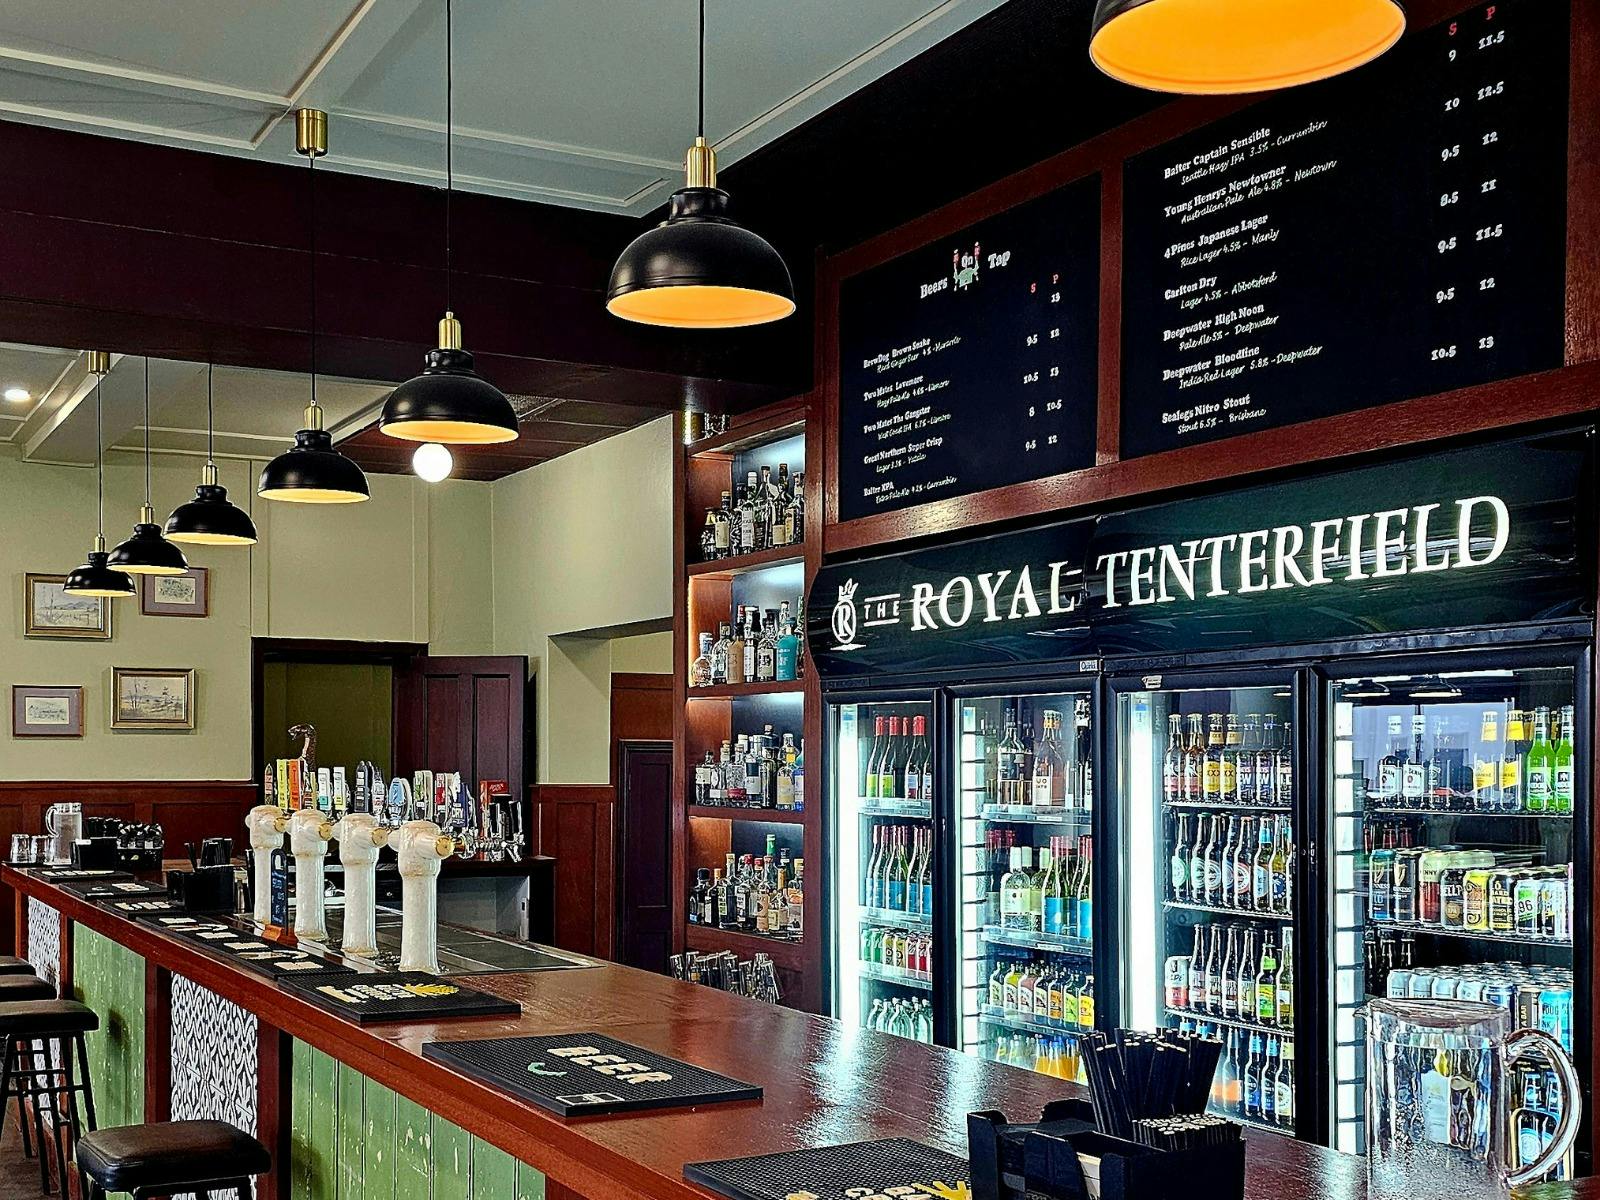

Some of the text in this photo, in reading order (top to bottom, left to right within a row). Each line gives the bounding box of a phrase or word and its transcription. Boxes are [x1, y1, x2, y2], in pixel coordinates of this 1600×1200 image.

[1486, 6, 1496, 20] P
[1449, 22, 1457, 36] S
[1478, 30, 1505, 49] 11.5
[1449, 50, 1456, 61] 9
[1478, 81, 1504, 100] 12.5
[1445, 98, 1460, 111] 10
[1482, 132, 1498, 145] 12
[1164, 127, 1271, 179] Balter Captain Sensible
[1181, 168, 1208, 185] Seattle
[1230, 153, 1245, 166] IPA
[1249, 142, 1269, 157] 3.5%
[1276, 120, 1327, 146] Currumbin
[1441, 145, 1460, 161] 9.5
[1164, 165, 1287, 217] Young Henrys Newtowner
[1181, 200, 1224, 224] Australian
[1225, 193, 1244, 208] Pale
[1248, 185, 1263, 199] Ale
[1263, 180, 1282, 192] 4.8%
[1294, 160, 1337, 182] Newtown
[1481, 179, 1496, 192] 11
[1440, 191, 1458, 206] 8.5
[1198, 223, 1239, 246] Japanese
[1241, 213, 1268, 231] Lager
[1476, 224, 1502, 240] 11.5
[1180, 256, 1198, 269] Rice
[1199, 247, 1222, 267] Lager
[1223, 241, 1241, 254] 4.5%
[1252, 228, 1279, 246] Manly
[1438, 237, 1456, 253] 9.5
[920, 277, 948, 299] Beers
[988, 250, 1011, 269] Tap
[1053, 274, 1059, 284] P
[1031, 282, 1036, 293] S
[1165, 275, 1217, 300] Carlton Dry
[1181, 297, 1203, 309] Lager
[1232, 271, 1277, 296] Abbotsford
[1480, 278, 1495, 290] 12
[1051, 292, 1060, 303] 13
[1436, 287, 1455, 303] 9.5
[1163, 303, 1264, 341] Deepwater High Noon
[1050, 328, 1060, 339] 12
[1180, 339, 1198, 351] Pale
[1198, 334, 1211, 346] Ale
[1212, 331, 1222, 342] 5%
[1235, 314, 1279, 336] Deepwater
[1479, 336, 1494, 349] 13
[864, 338, 931, 368] BrewDog Brown Snake
[1431, 346, 1456, 360] 10.5
[1163, 345, 1260, 381] Deepwater Bloodline
[1023, 372, 1039, 385] 10.5
[1050, 366, 1059, 377] 13
[1179, 375, 1204, 390] India
[1204, 371, 1220, 383] Red
[1220, 365, 1245, 381] Lager
[1250, 357, 1269, 370] 5.8%
[864, 392, 876, 401] Two
[876, 385, 893, 397] Mates
[1029, 406, 1035, 417] 8
[1047, 399, 1062, 412] 10.5
[1162, 393, 1251, 424] Sealegs Nitro Stout
[864, 406, 931, 433] Two Mates The Gangster
[1178, 421, 1198, 435] Stout
[1199, 416, 1216, 429] 6.5%
[1229, 407, 1266, 423] Brisbane
[1025, 440, 1036, 451] 9.5
[1048, 435, 1057, 445] 12
[864, 437, 943, 464] Great Northern Super Crisp
[864, 481, 895, 496] Balter XPA
[864, 495, 1511, 632] THE ROYAL TENTERFIELD
[547, 1046, 673, 1085] BEER
